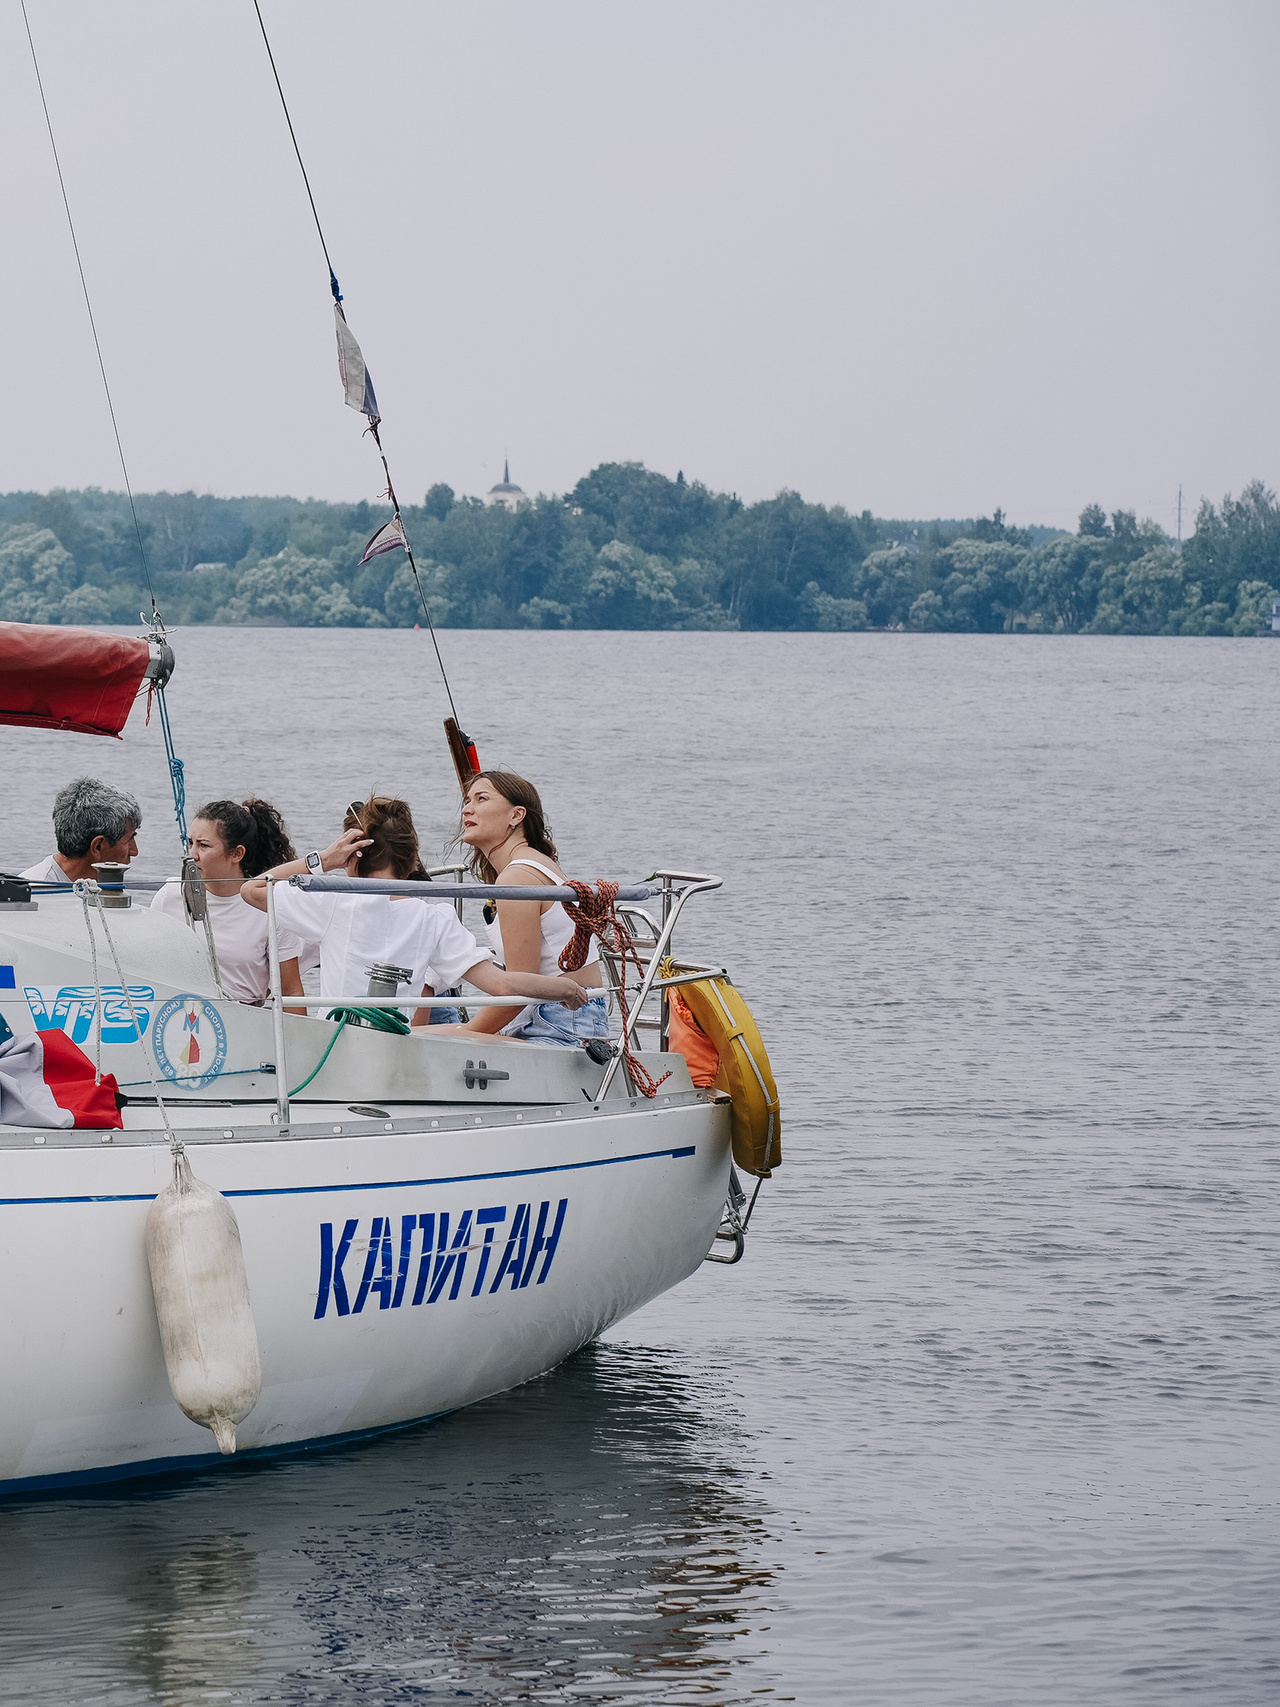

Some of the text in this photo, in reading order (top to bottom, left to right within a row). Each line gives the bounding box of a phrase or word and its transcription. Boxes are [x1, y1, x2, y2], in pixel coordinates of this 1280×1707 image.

[155, 1000, 181, 1046] ПАРУСНОМУ
[204, 1006, 224, 1040] СПОРТУ
[156, 1048, 167, 1065] ЛЕТ
[314, 1198, 569, 1320] КАПИТАН
